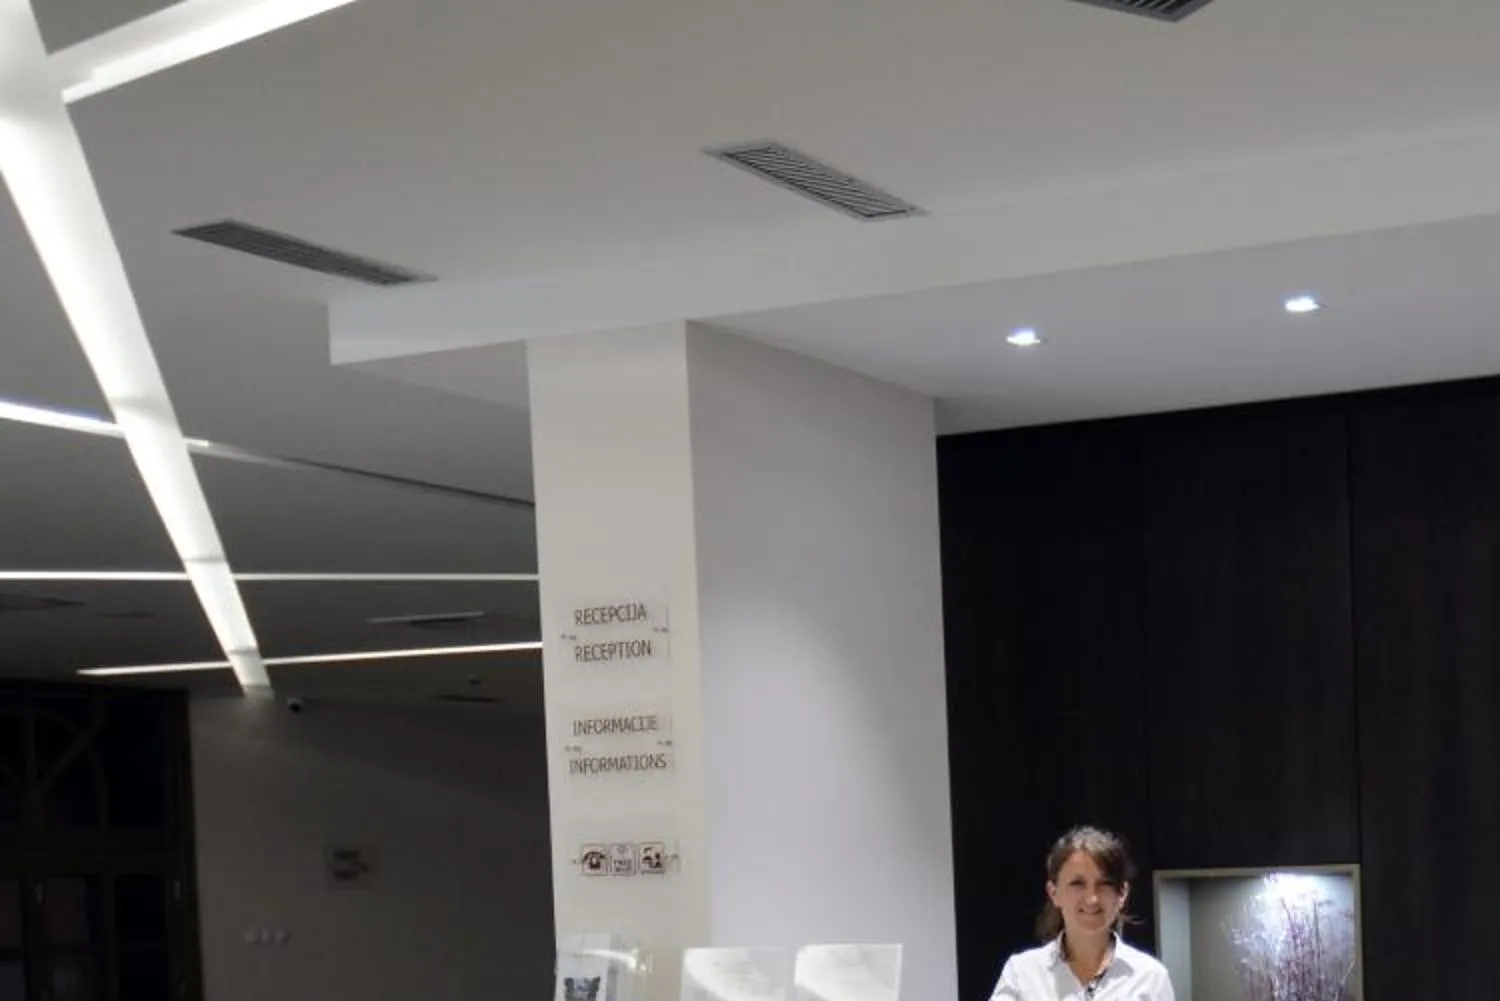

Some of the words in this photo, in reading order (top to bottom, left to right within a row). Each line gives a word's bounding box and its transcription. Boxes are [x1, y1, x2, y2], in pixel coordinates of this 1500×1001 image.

[574, 603, 647, 625] RECEPCIJA
[574, 640, 651, 662] RECEPTION
[573, 715, 657, 736] INFORMACIJE
[569, 753, 667, 774] INFORMATIONS
